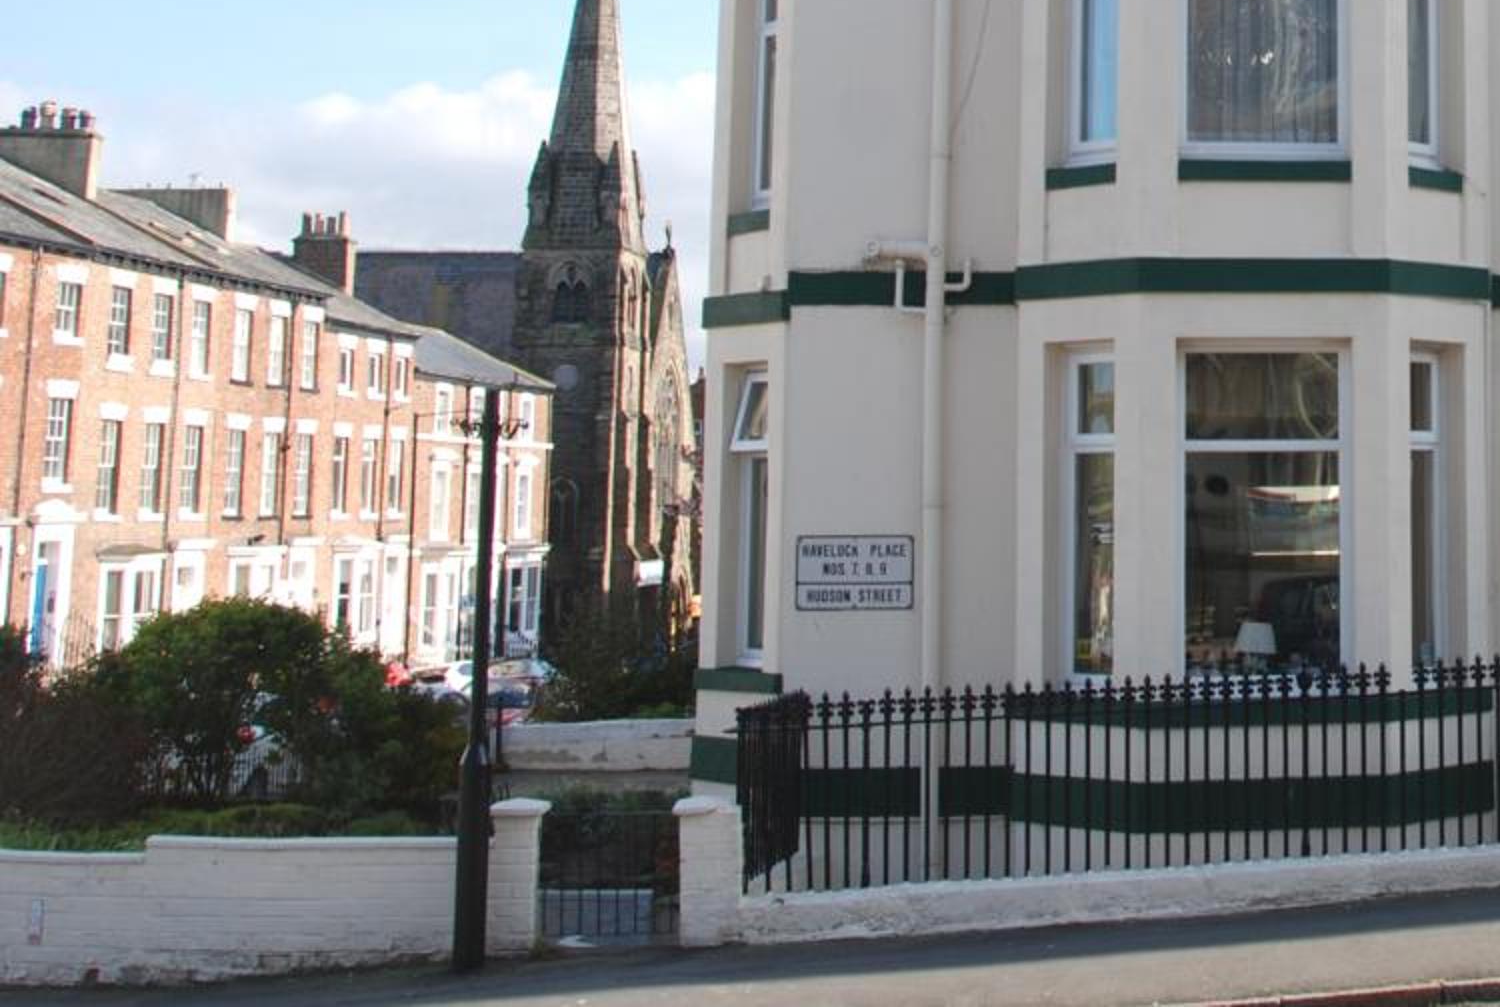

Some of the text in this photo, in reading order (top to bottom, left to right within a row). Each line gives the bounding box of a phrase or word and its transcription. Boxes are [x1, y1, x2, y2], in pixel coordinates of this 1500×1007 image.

[801, 544, 907, 558] HAVELOCK PLACE
[807, 589, 902, 603] HUDSON STREET
